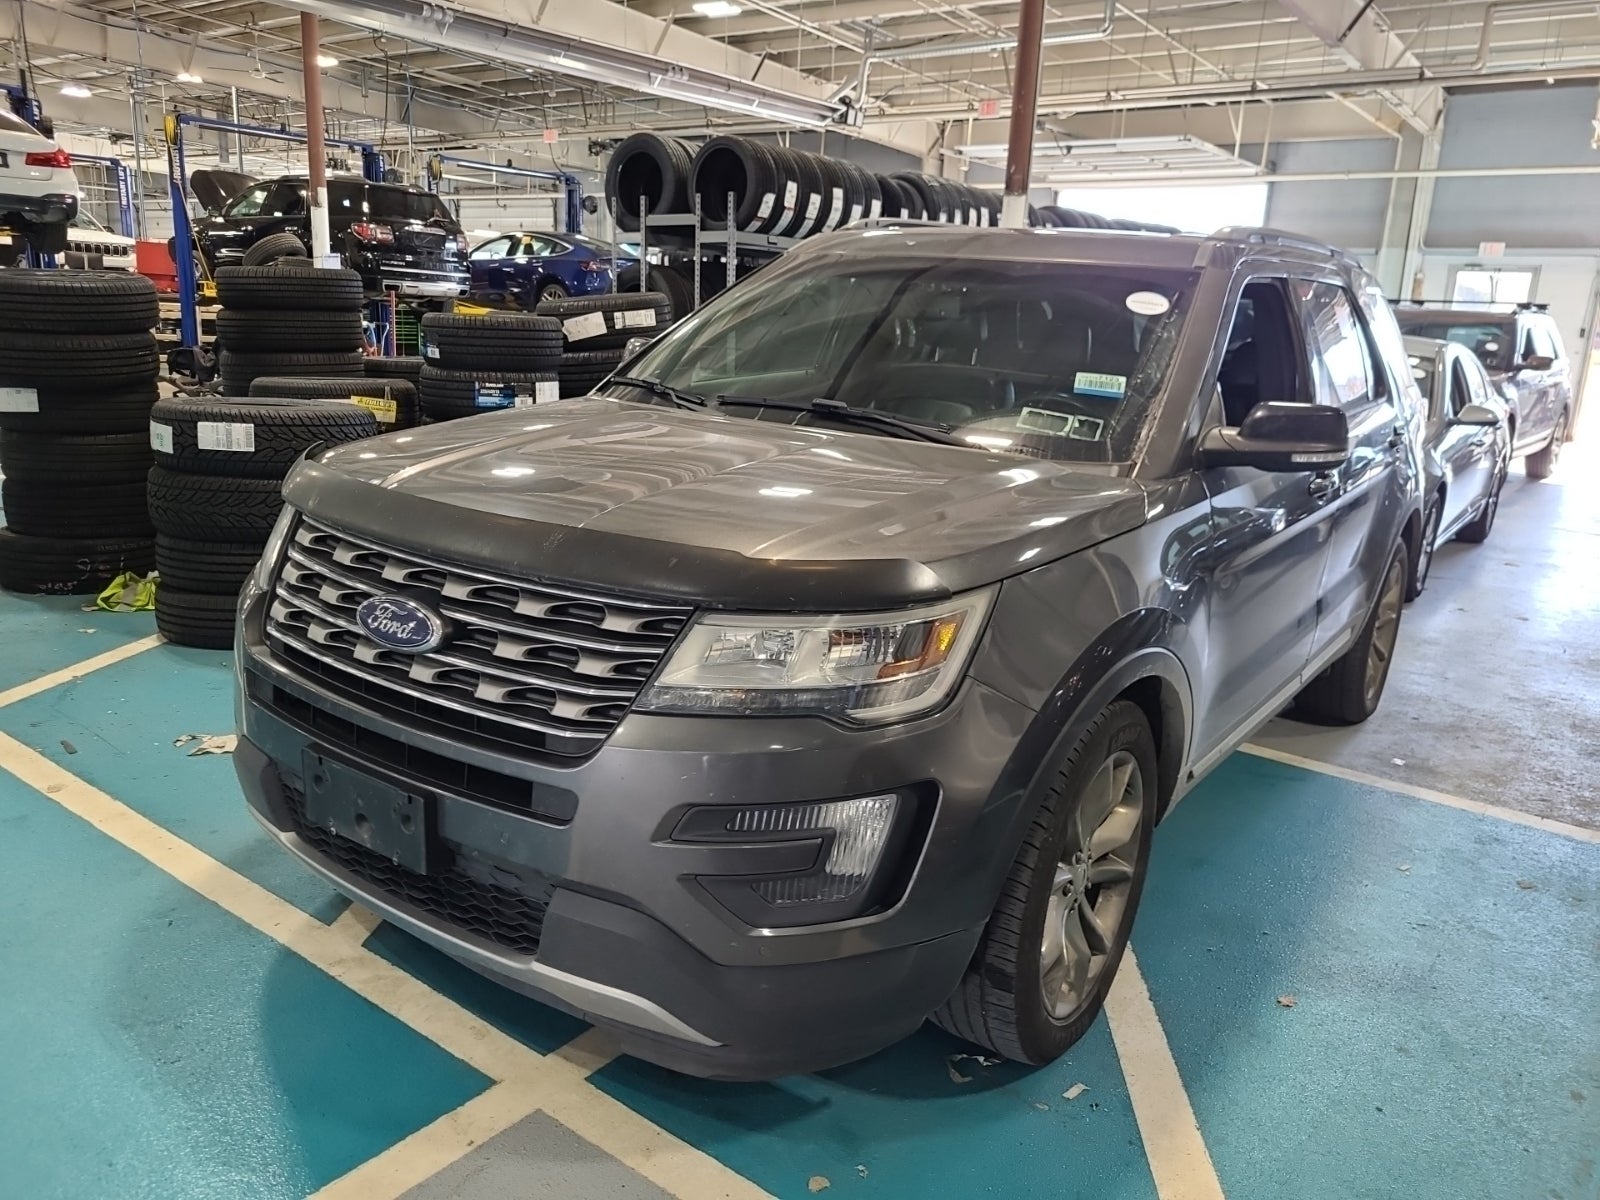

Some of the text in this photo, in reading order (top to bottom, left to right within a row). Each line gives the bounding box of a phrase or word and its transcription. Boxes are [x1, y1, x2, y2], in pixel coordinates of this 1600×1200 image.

[118, 166, 128, 205] ROTARY LIFT
[367, 603, 417, 639] Ford
